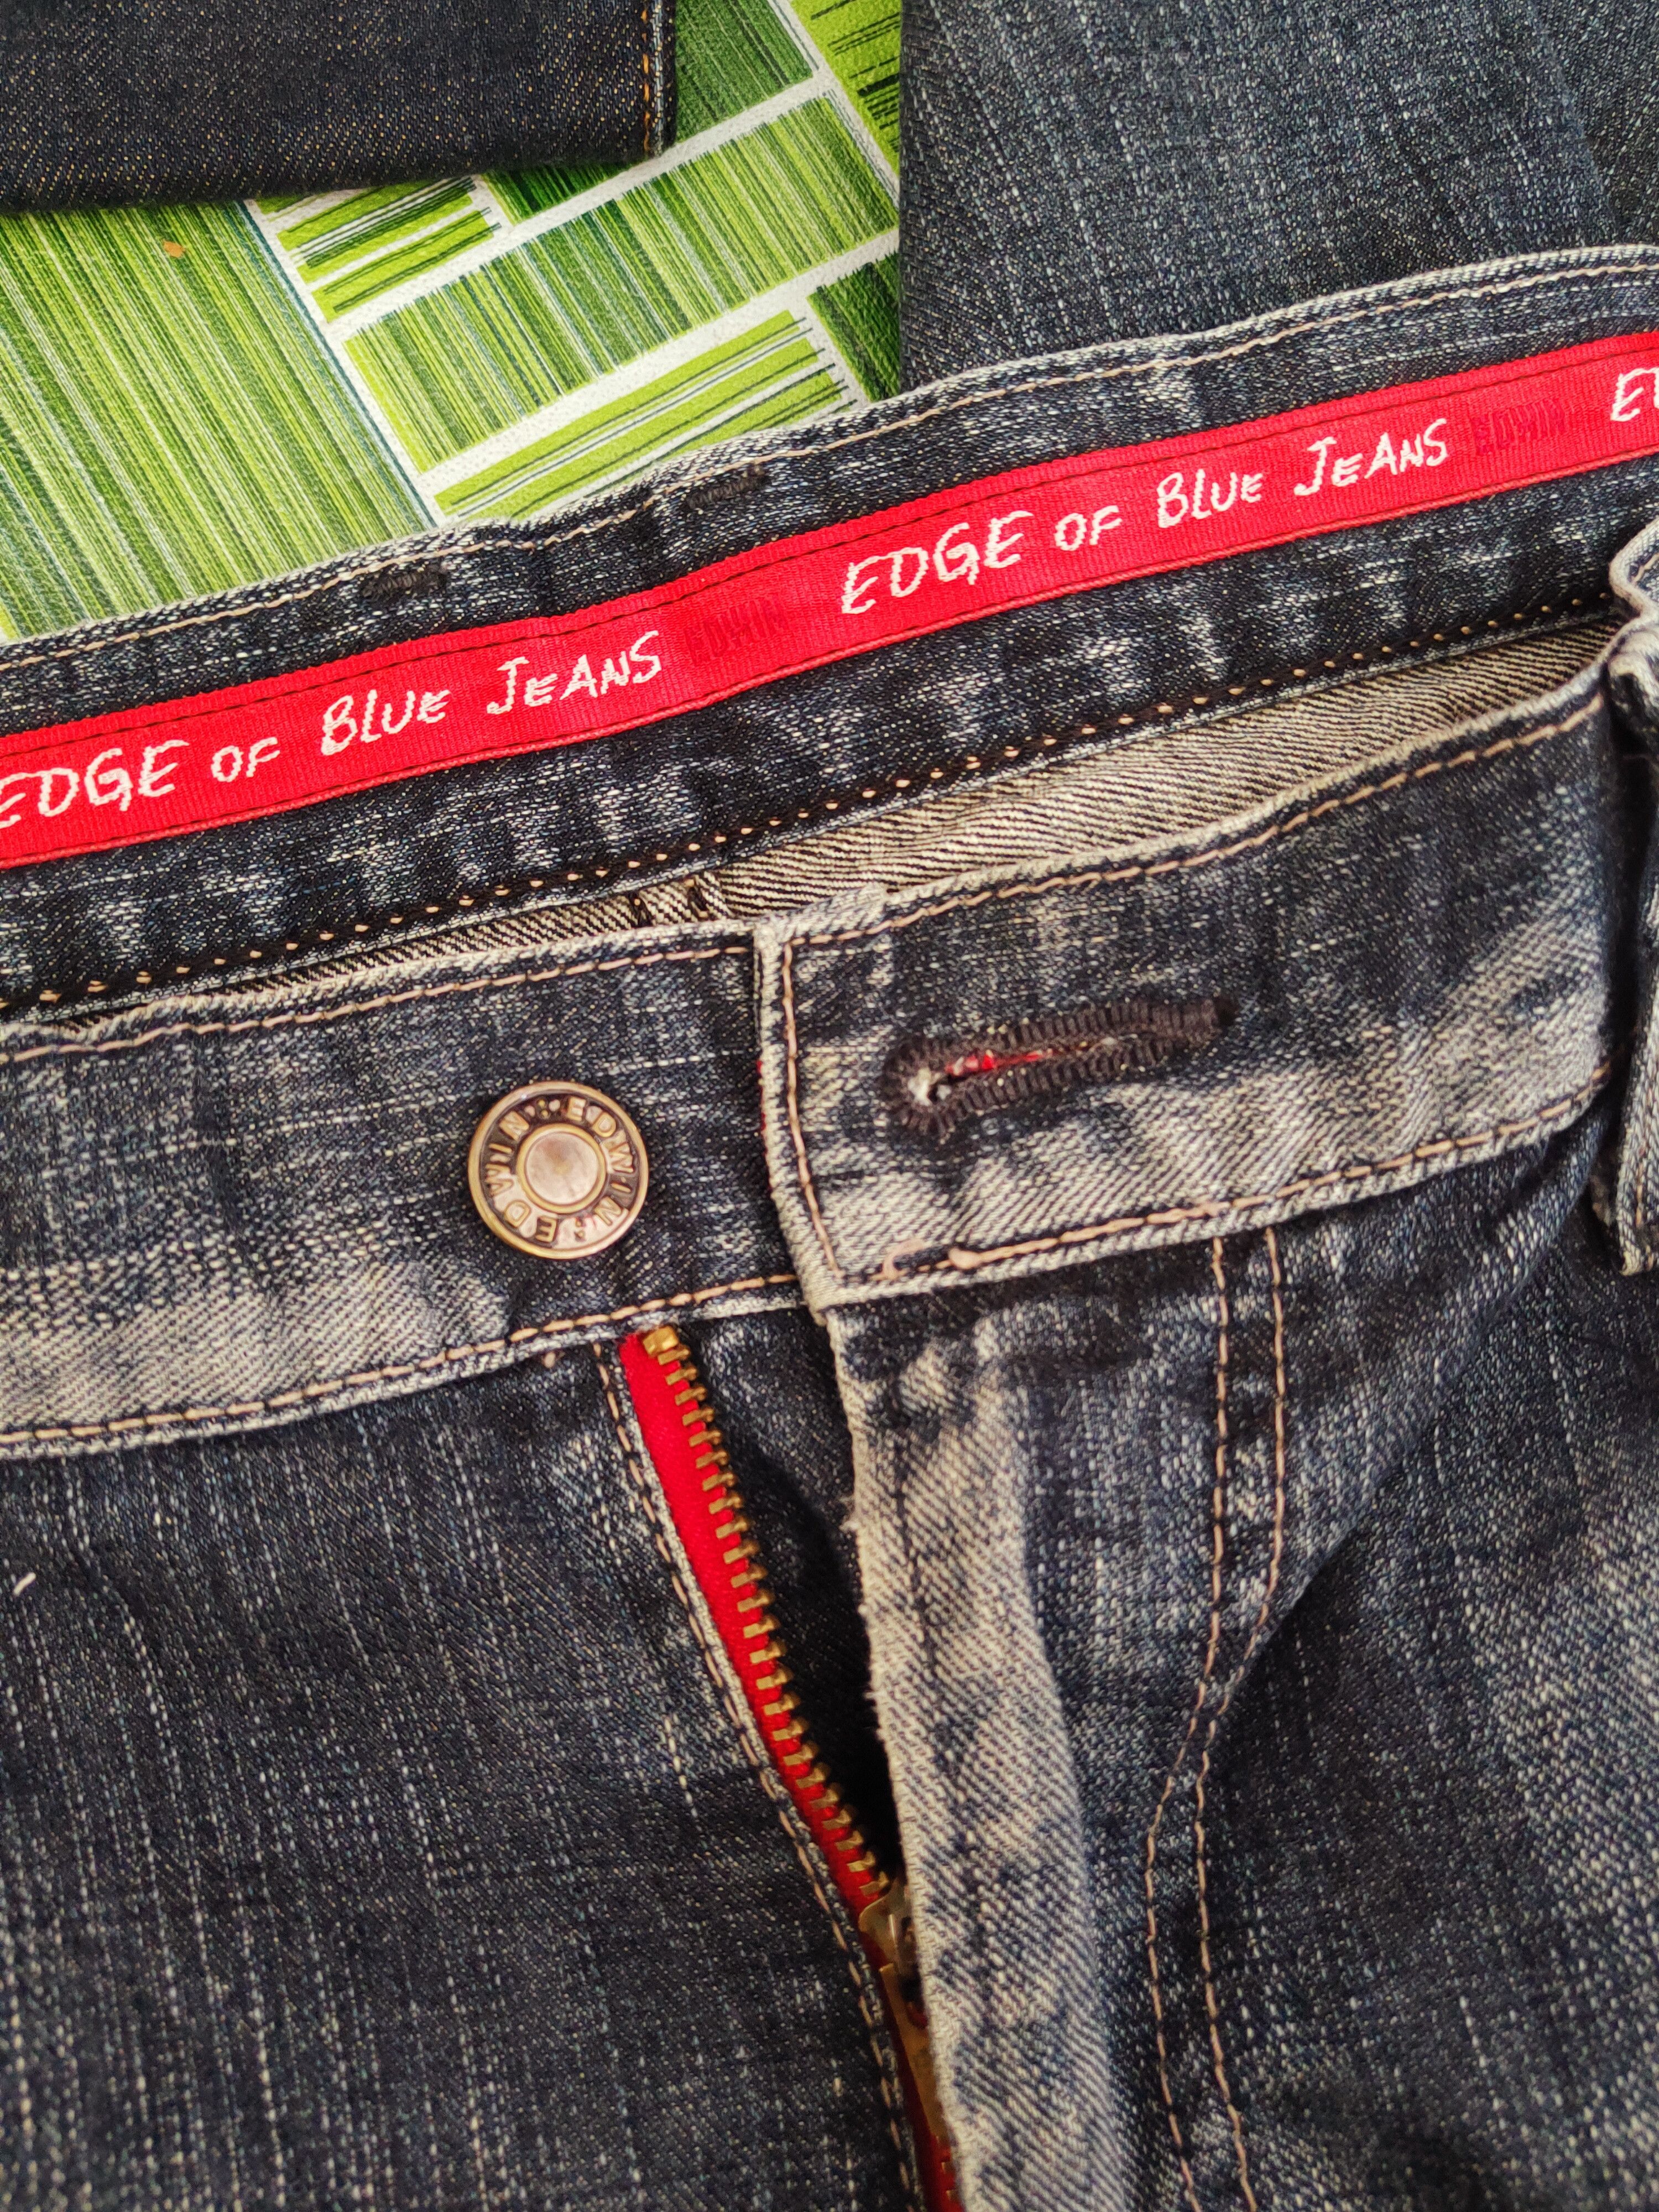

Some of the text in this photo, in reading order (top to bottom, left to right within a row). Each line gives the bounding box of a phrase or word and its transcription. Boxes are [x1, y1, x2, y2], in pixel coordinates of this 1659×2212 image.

[0, 739, 190, 829] EDGE
[210, 737, 280, 782] OF
[320, 689, 451, 756] BLUE
[486, 630, 662, 715] JEANS
[841, 510, 1034, 615] EDGE
[1054, 504, 1123, 551] OF
[1156, 468, 1263, 529] BLUE
[1293, 418, 1448, 497] JEANS
[484, 1109, 557, 1243] EDWIN
[565, 1095, 635, 1227] EDWIN
